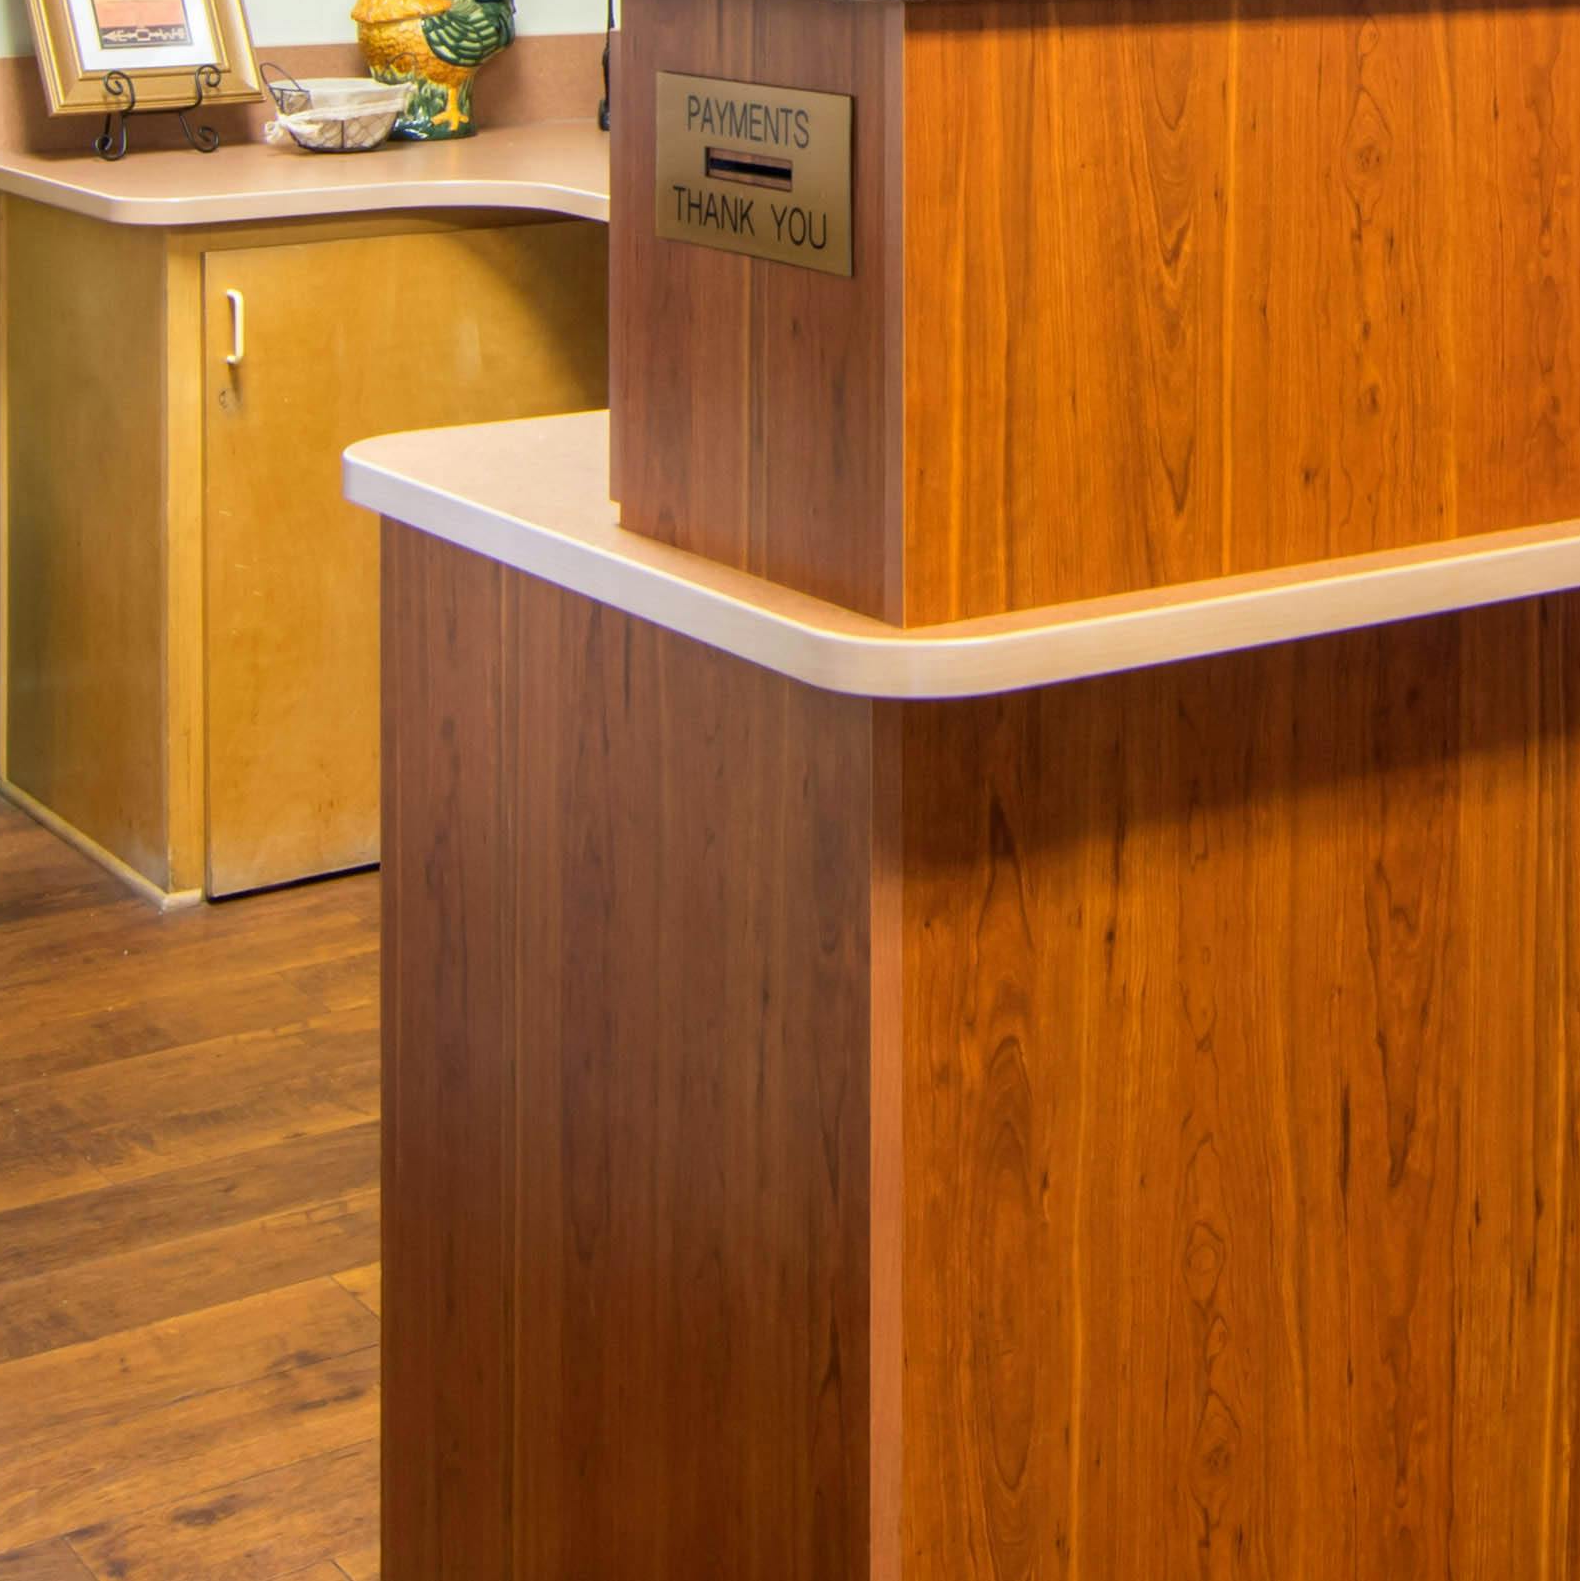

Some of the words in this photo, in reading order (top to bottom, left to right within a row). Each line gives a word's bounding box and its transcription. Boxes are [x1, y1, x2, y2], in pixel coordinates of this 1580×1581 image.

[687, 94, 810, 149] PAYMENTS
[673, 185, 756, 236] THANK
[771, 203, 827, 250] YOU
